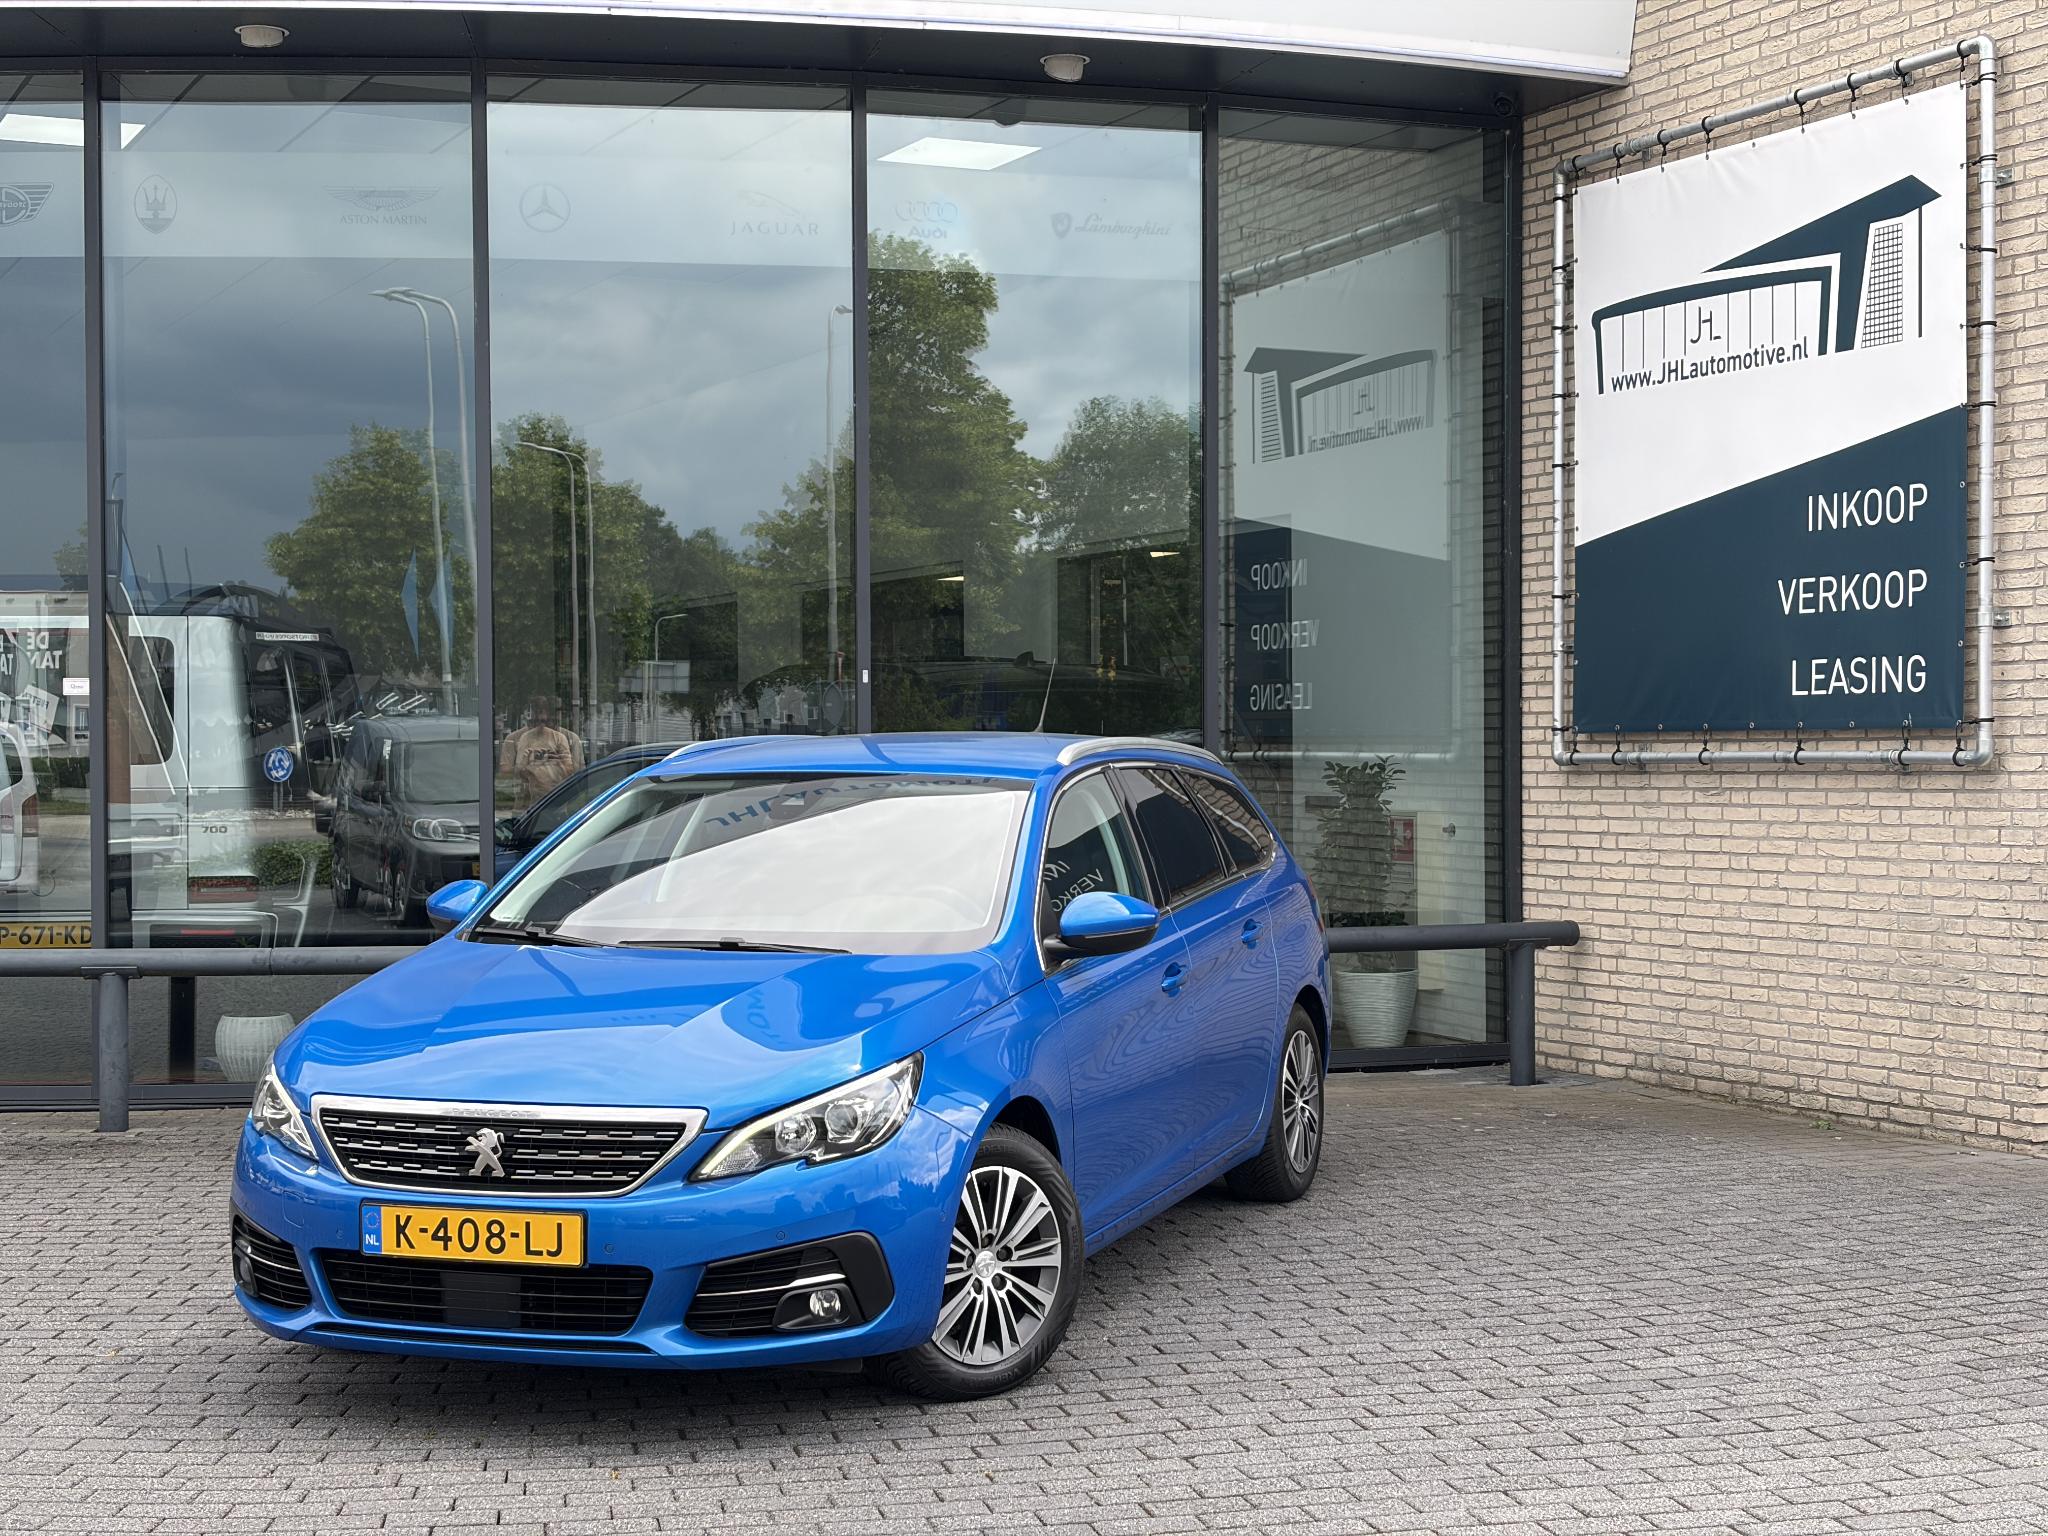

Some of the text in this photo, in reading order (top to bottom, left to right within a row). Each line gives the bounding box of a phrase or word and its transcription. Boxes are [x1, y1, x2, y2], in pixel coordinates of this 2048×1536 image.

[339, 214, 428, 225] ASTON MARTIN
[730, 220, 820, 237] JAGUAR
[1611, 336, 1809, 392] www.JHLautomotive.nl
[1807, 483, 1928, 532] INKOOP
[1777, 568, 1928, 616] VERKOOP
[1791, 654, 1927, 696] LEASING
[365, 1233, 380, 1246] NL
[394, 1214, 563, 1258] K-408-LJ
